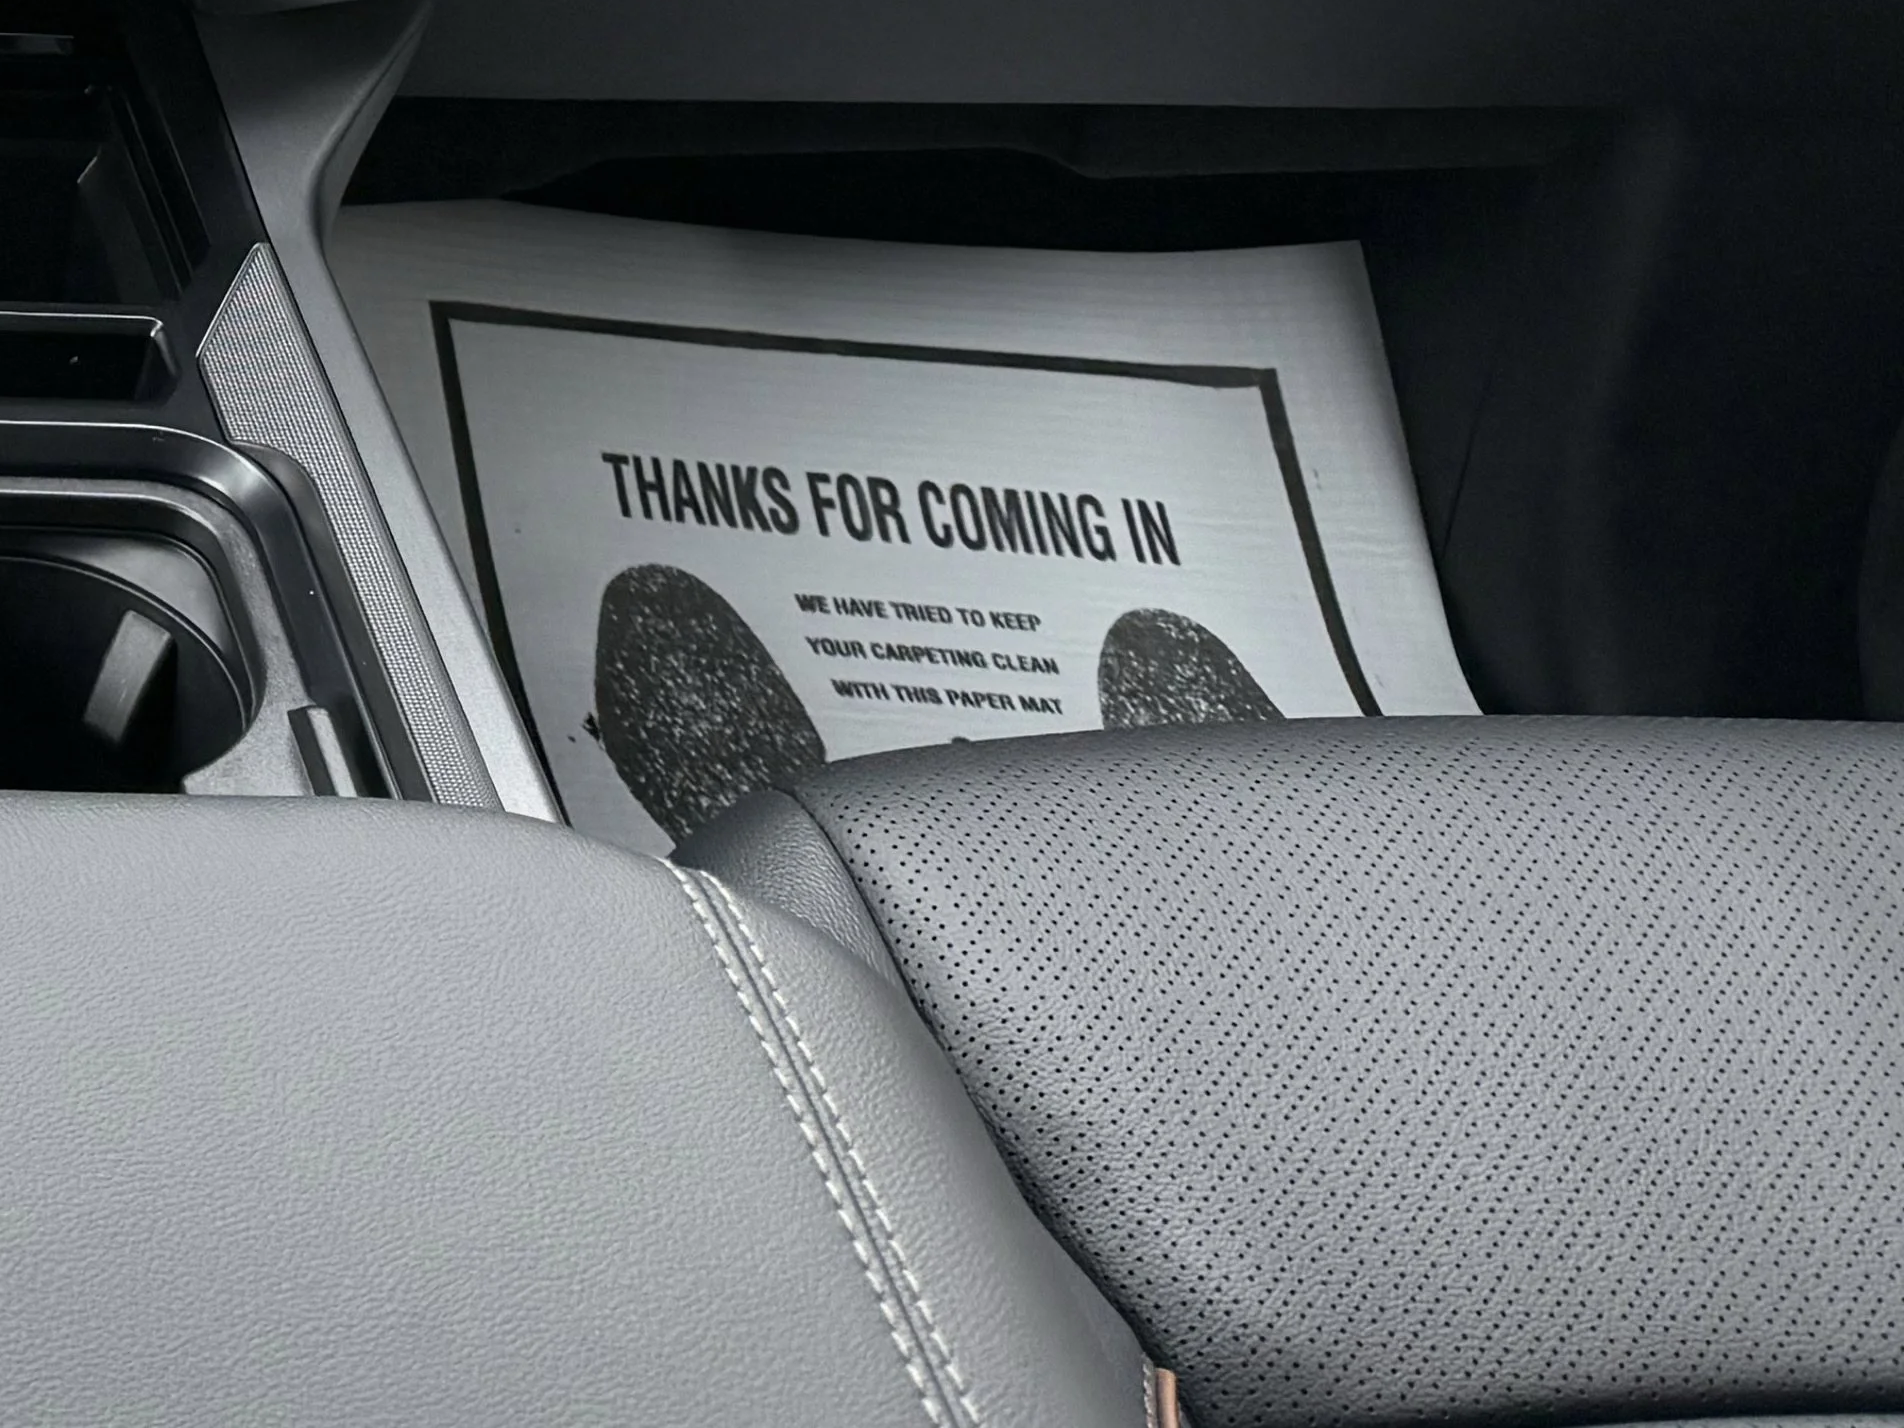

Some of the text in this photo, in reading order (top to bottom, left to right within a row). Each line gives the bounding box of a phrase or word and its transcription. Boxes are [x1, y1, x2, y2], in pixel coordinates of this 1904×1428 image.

[600, 451, 1183, 567] THANKS FOR COMING IN
[794, 593, 1042, 632] WE HAVE TRIED TO KEEP
[805, 636, 1060, 676] YOUR CARPETING CLEAN
[831, 679, 1065, 716] WITH THIS PAPER MAT
